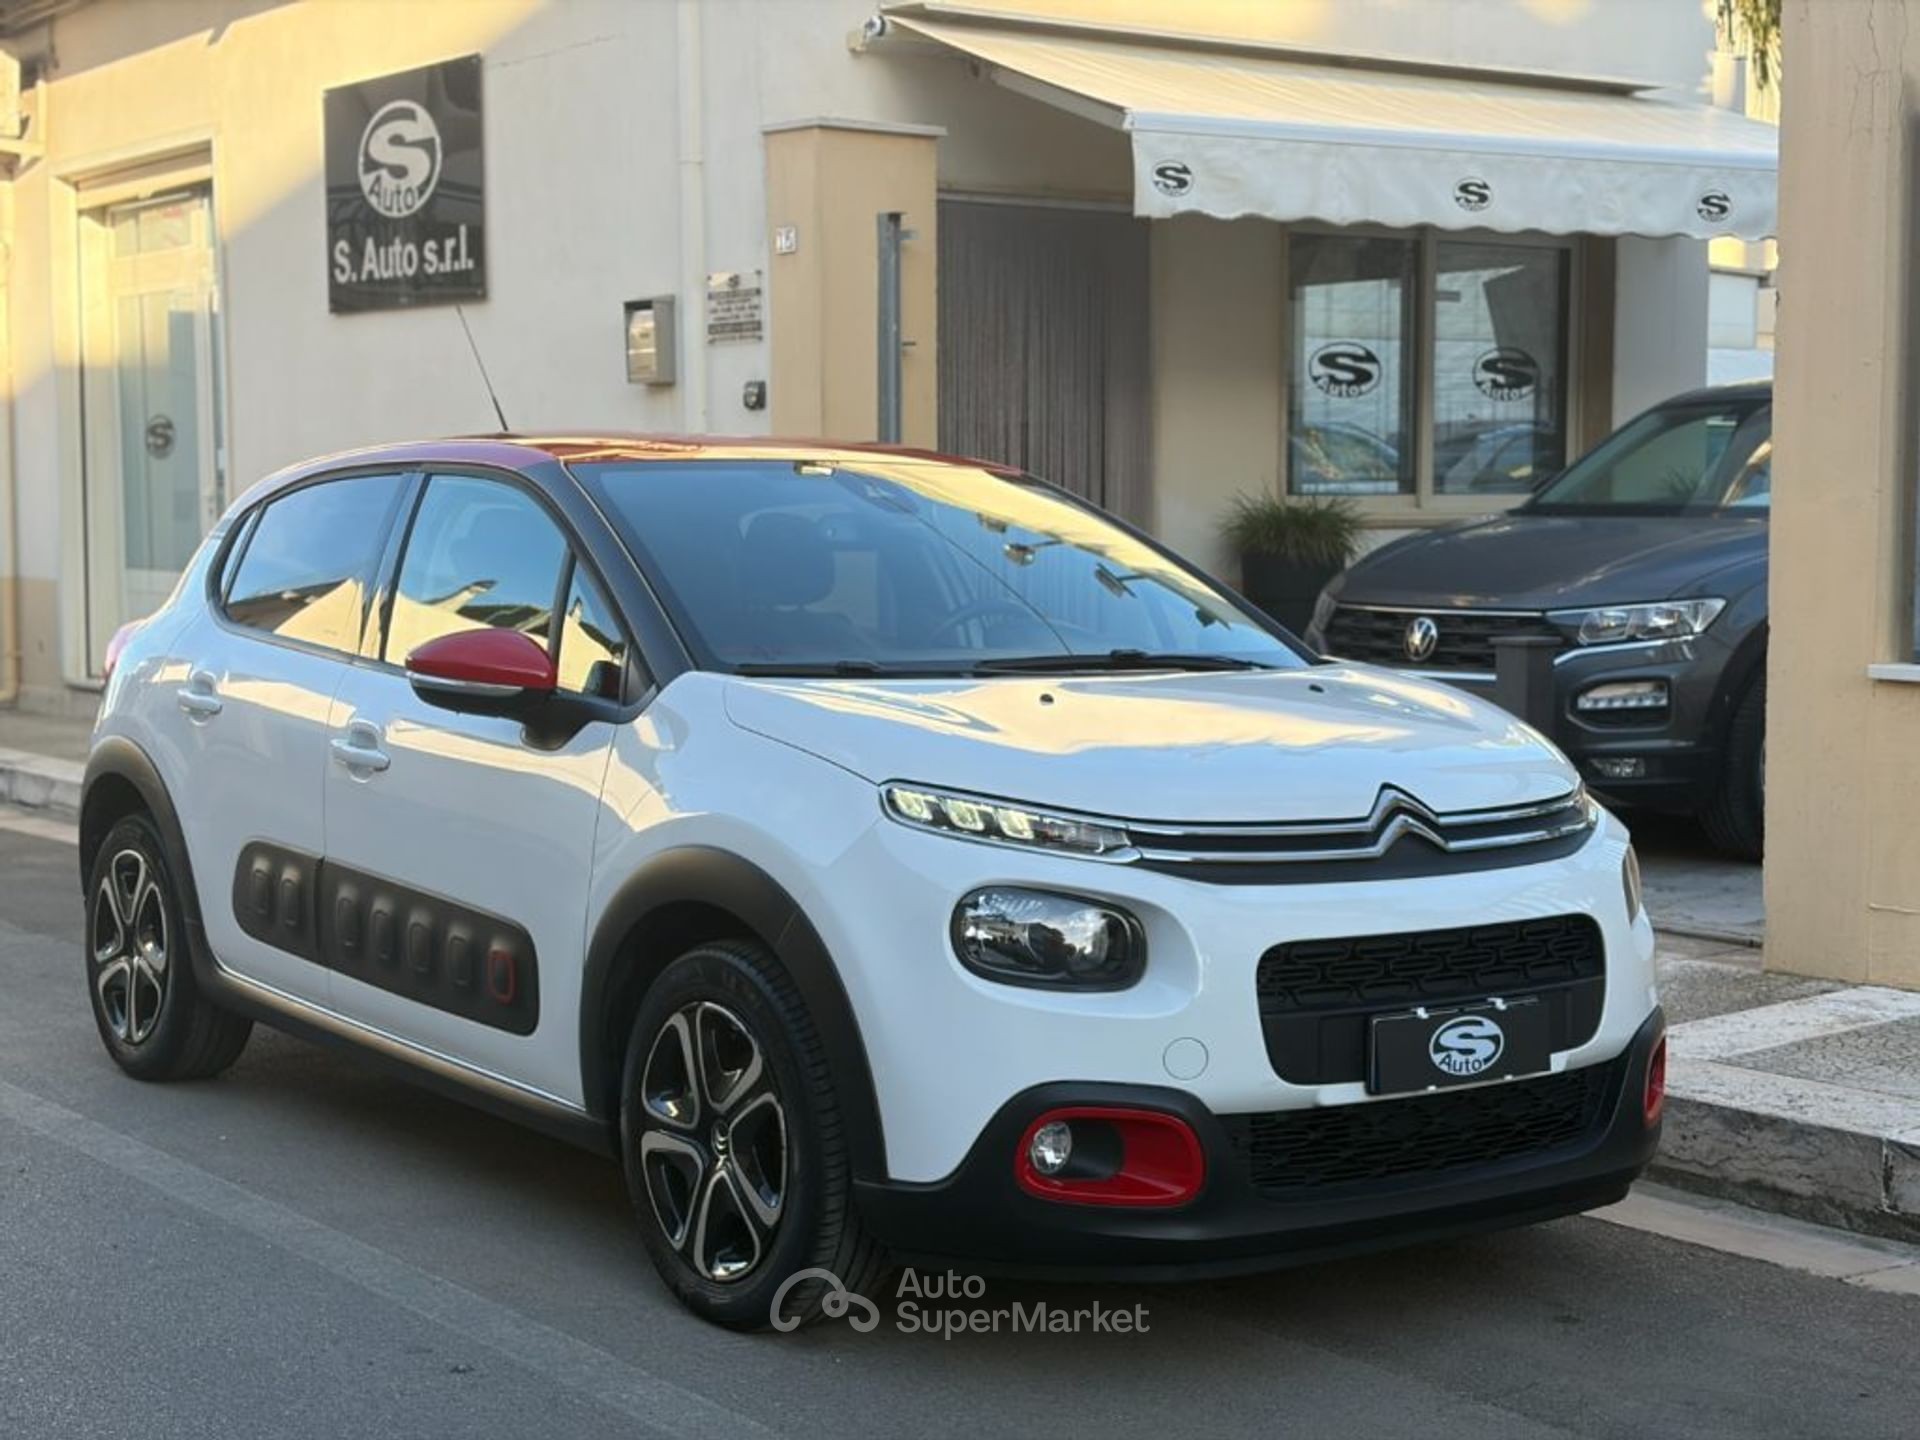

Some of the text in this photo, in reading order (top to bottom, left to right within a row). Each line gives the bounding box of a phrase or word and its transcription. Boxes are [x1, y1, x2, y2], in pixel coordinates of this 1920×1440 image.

[368, 174, 420, 213] Auto
[333, 223, 475, 285] S. Auto s.r.l.
[1316, 377, 1361, 398] Auto
[1482, 382, 1521, 400] Auto
[1438, 1053, 1484, 1073] Auto
